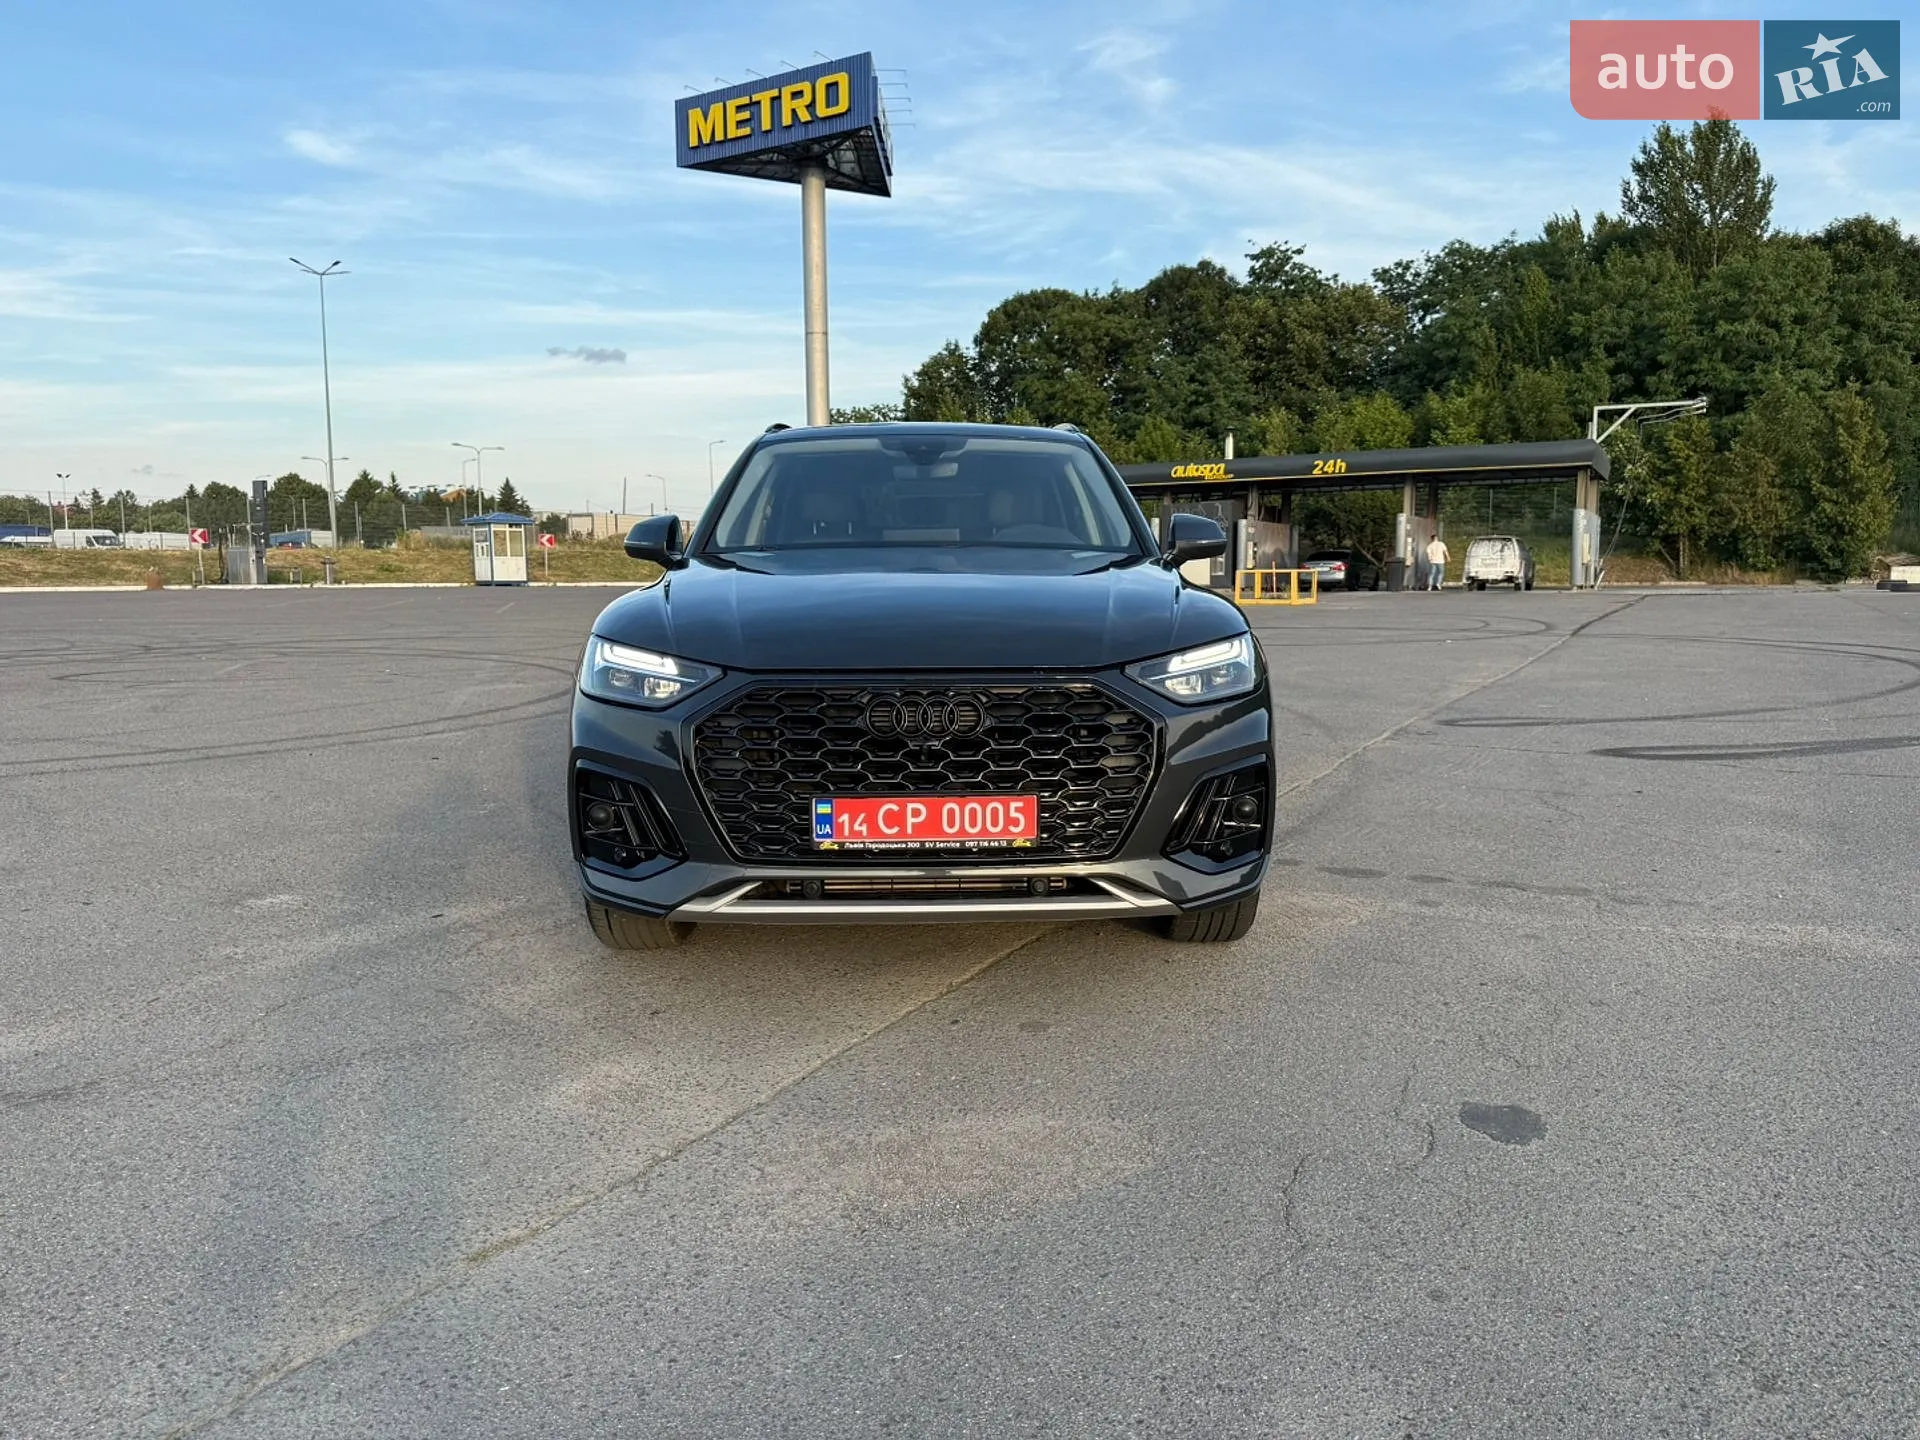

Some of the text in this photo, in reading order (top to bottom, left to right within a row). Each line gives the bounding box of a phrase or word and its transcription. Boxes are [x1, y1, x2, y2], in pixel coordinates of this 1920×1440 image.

[687, 71, 849, 148] METRO
[1170, 463, 1226, 480] autospa
[1312, 459, 1346, 475] 24h
[838, 812, 868, 837] 14
[941, 801, 1025, 834] 0005
[816, 824, 832, 835] UA
